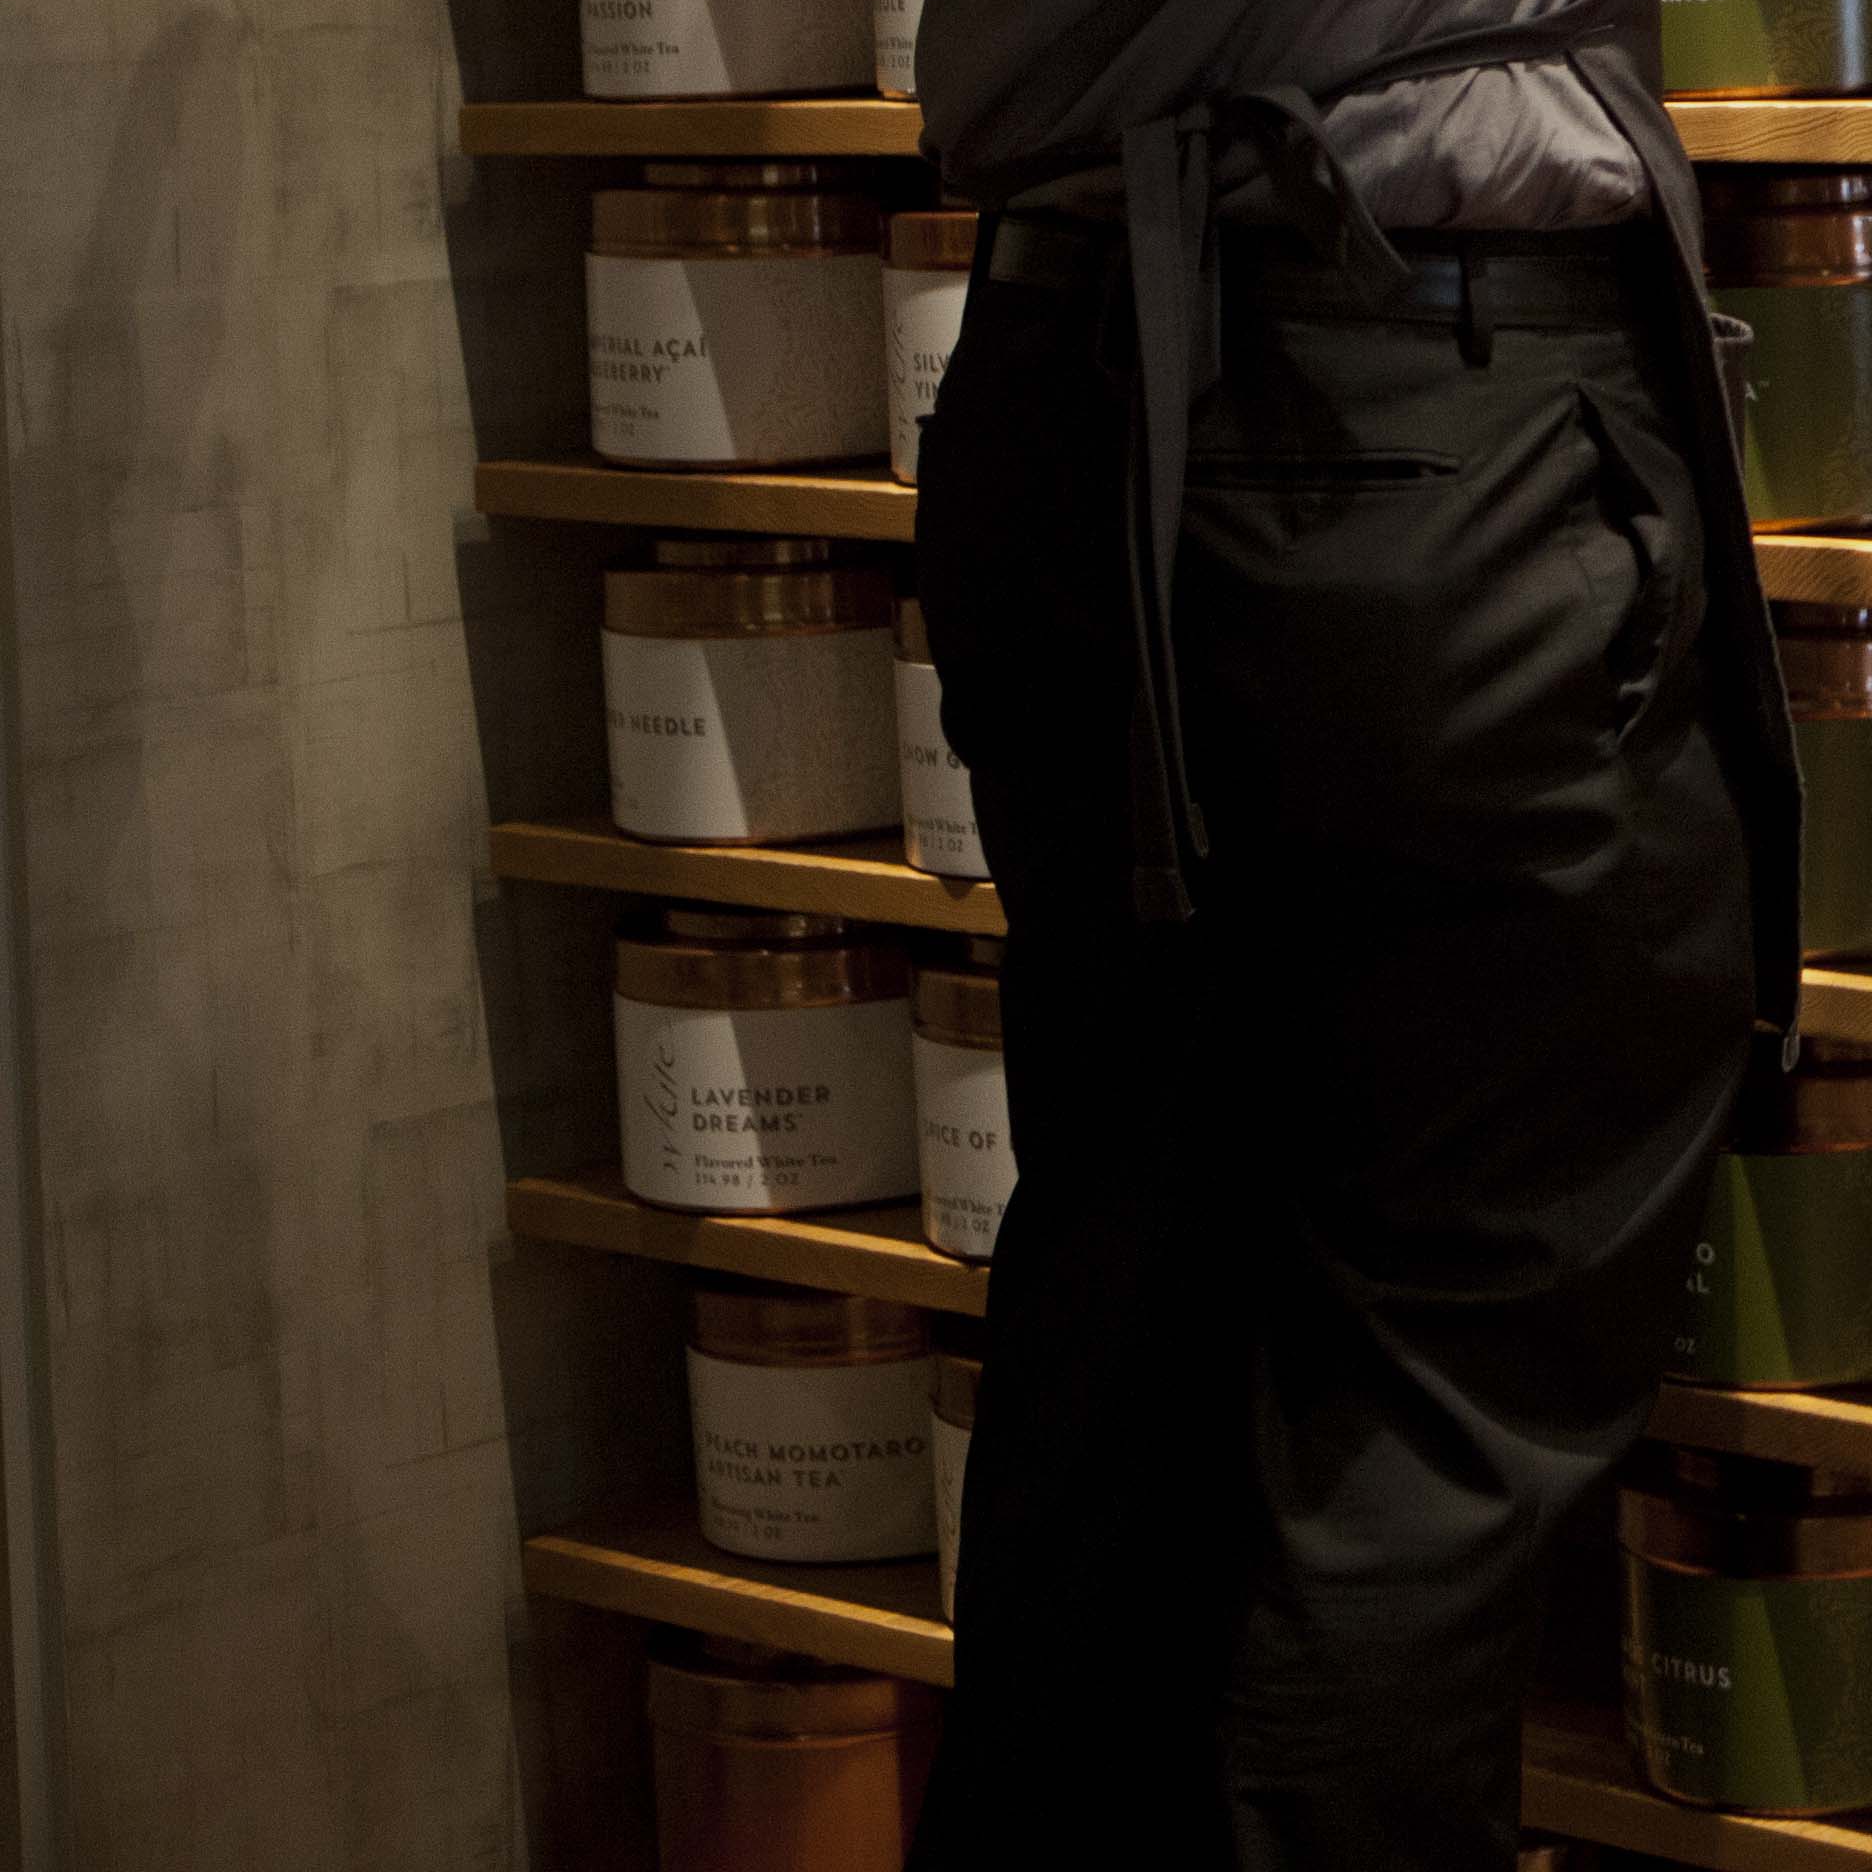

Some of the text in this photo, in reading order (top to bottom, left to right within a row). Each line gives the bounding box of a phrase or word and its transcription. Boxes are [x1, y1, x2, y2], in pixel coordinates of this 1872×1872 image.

[913, 353, 949, 373] SILV
[629, 713, 706, 736] NEEDLE
[691, 1084, 830, 1106] LAVENDER
[969, 1130, 998, 1149] OF
[768, 1436, 926, 1462] MOMOTARO
[794, 1470, 842, 1488] TEA
[1651, 1652, 1732, 1689] CITRUS
